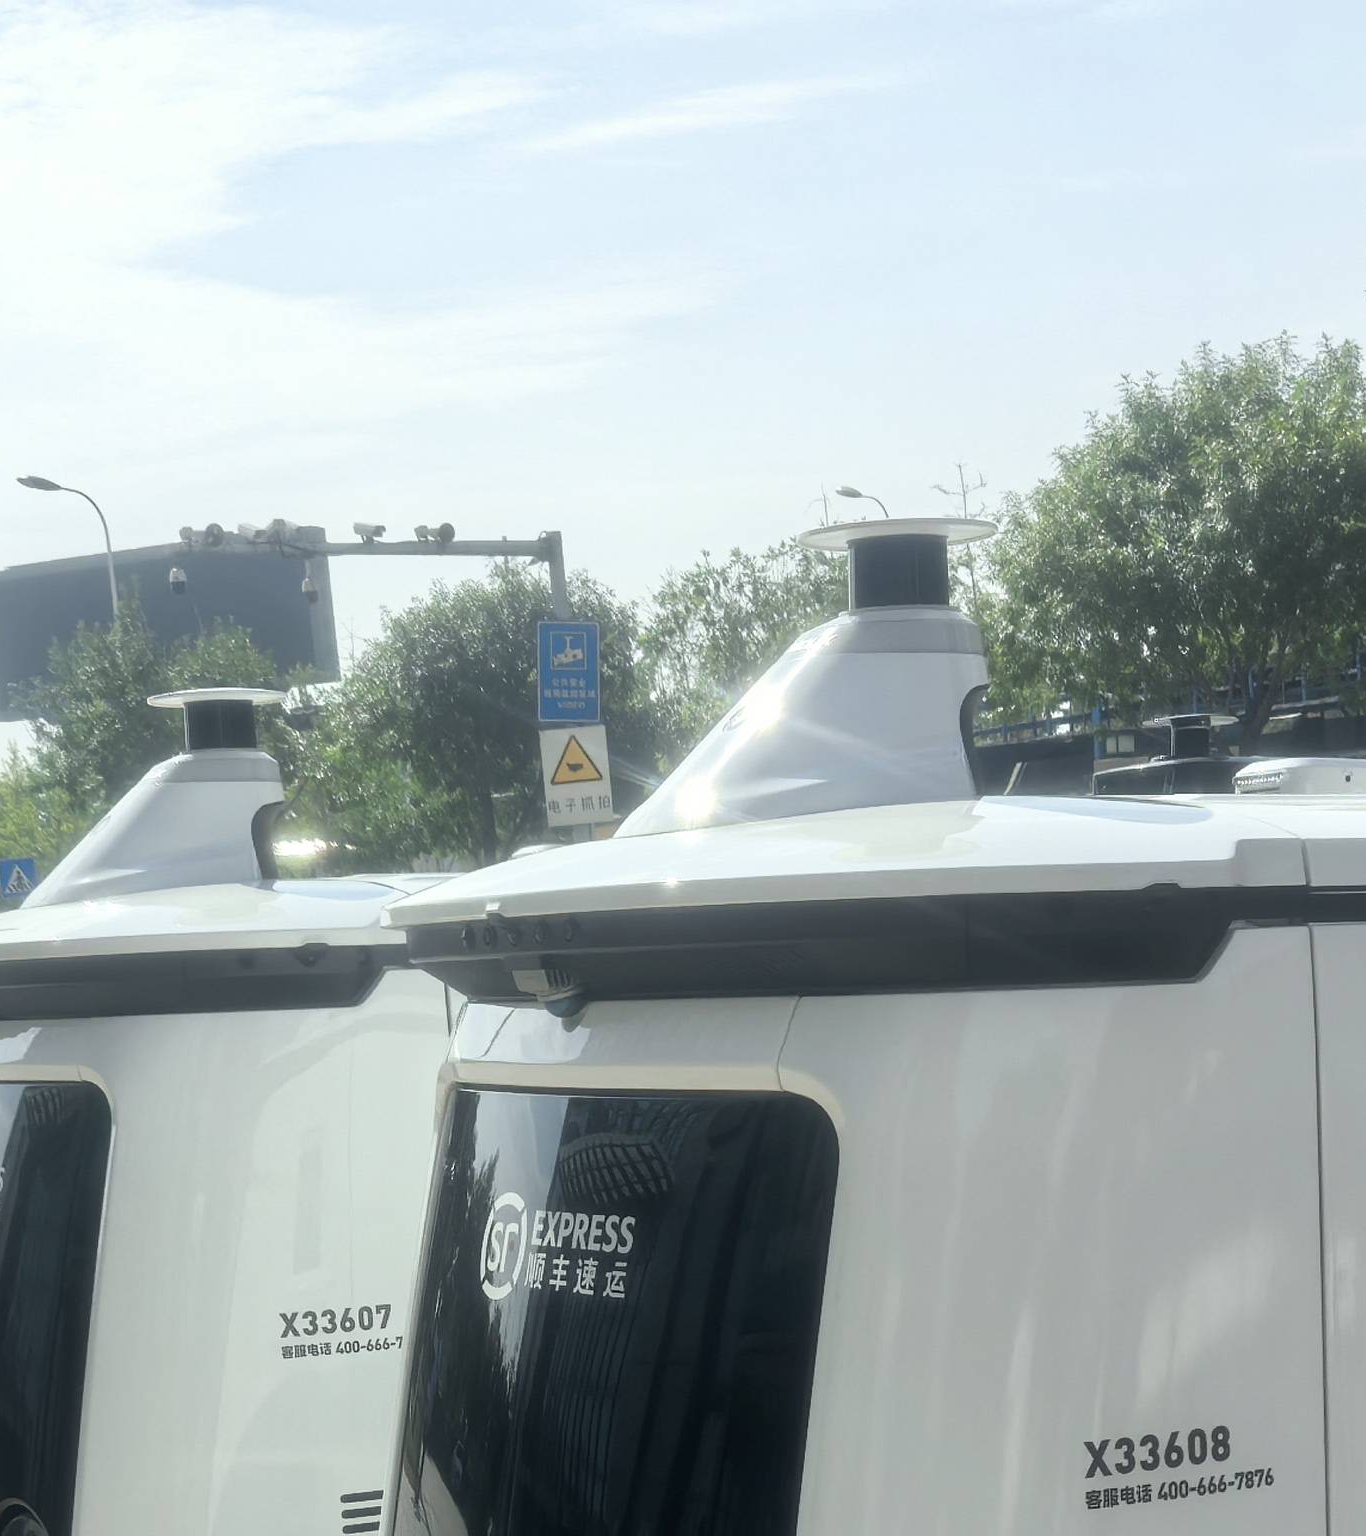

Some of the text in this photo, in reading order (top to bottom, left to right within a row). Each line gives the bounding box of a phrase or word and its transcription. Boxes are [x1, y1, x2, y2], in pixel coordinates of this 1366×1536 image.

[531, 1209, 636, 1254] EXPRESS
[524, 1252, 628, 1299] 顺丰速运
[279, 1304, 391, 1338] X33607
[281, 1342, 332, 1359] 客服电话
[1083, 1425, 1231, 1479] X33608
[1085, 1468, 1274, 1510] 客服电话 400-666-7876
